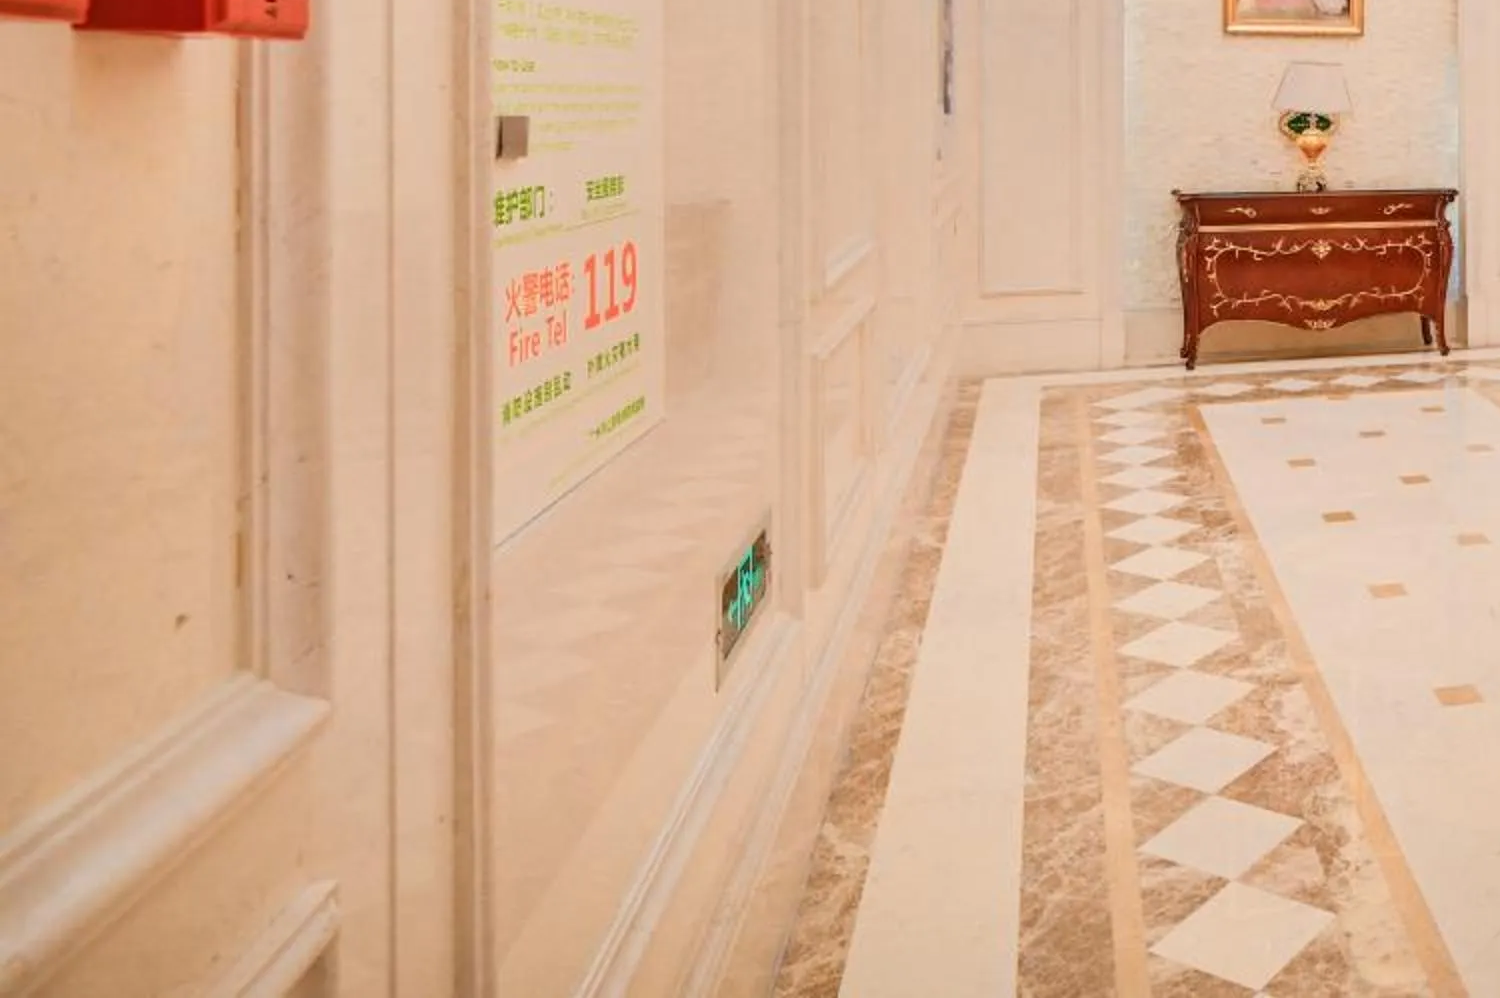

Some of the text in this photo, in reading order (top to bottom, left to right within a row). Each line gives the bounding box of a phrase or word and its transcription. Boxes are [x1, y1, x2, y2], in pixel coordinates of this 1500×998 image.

[584, 240, 638, 330] 119
[509, 309, 567, 367] Fire Tel
